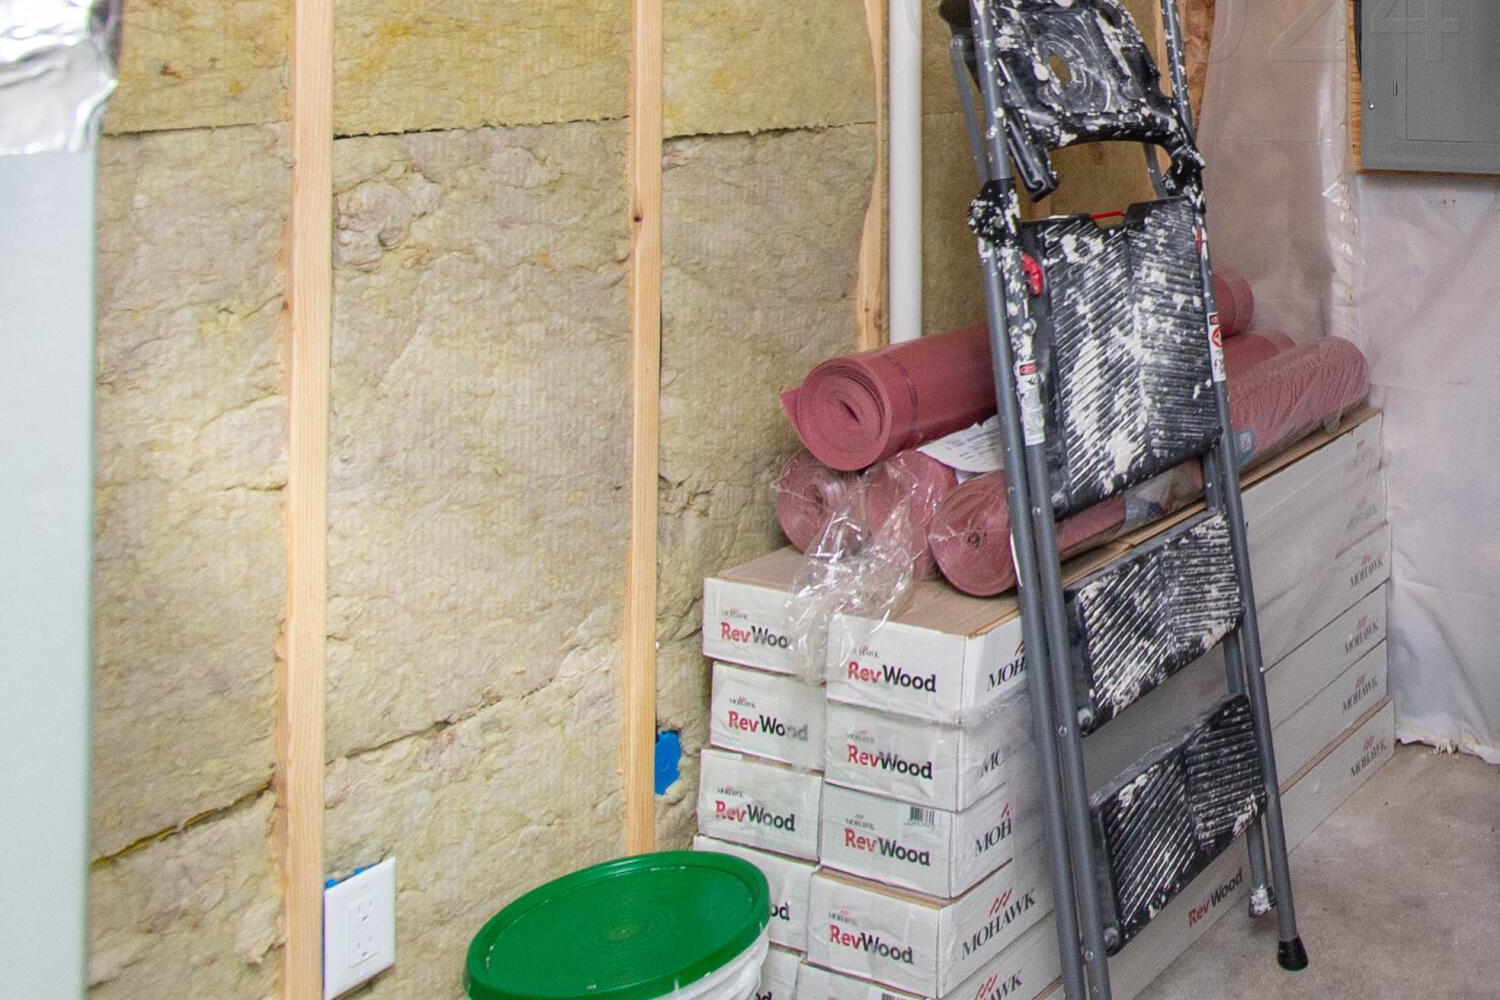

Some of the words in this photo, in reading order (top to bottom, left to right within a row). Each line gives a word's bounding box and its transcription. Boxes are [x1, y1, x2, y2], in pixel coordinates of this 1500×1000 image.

[721, 621, 789, 649] RevWoo
[848, 661, 937, 693] RevWood
[986, 655, 1026, 692] MOH
[847, 744, 933, 780] RevWood
[715, 800, 796, 832] RevWood
[844, 827, 931, 867] RevWood
[974, 818, 1012, 858] MOH
[1188, 866, 1243, 929] RevWood
[961, 888, 1036, 961] MOHAWK
[829, 923, 914, 965] RevWood
